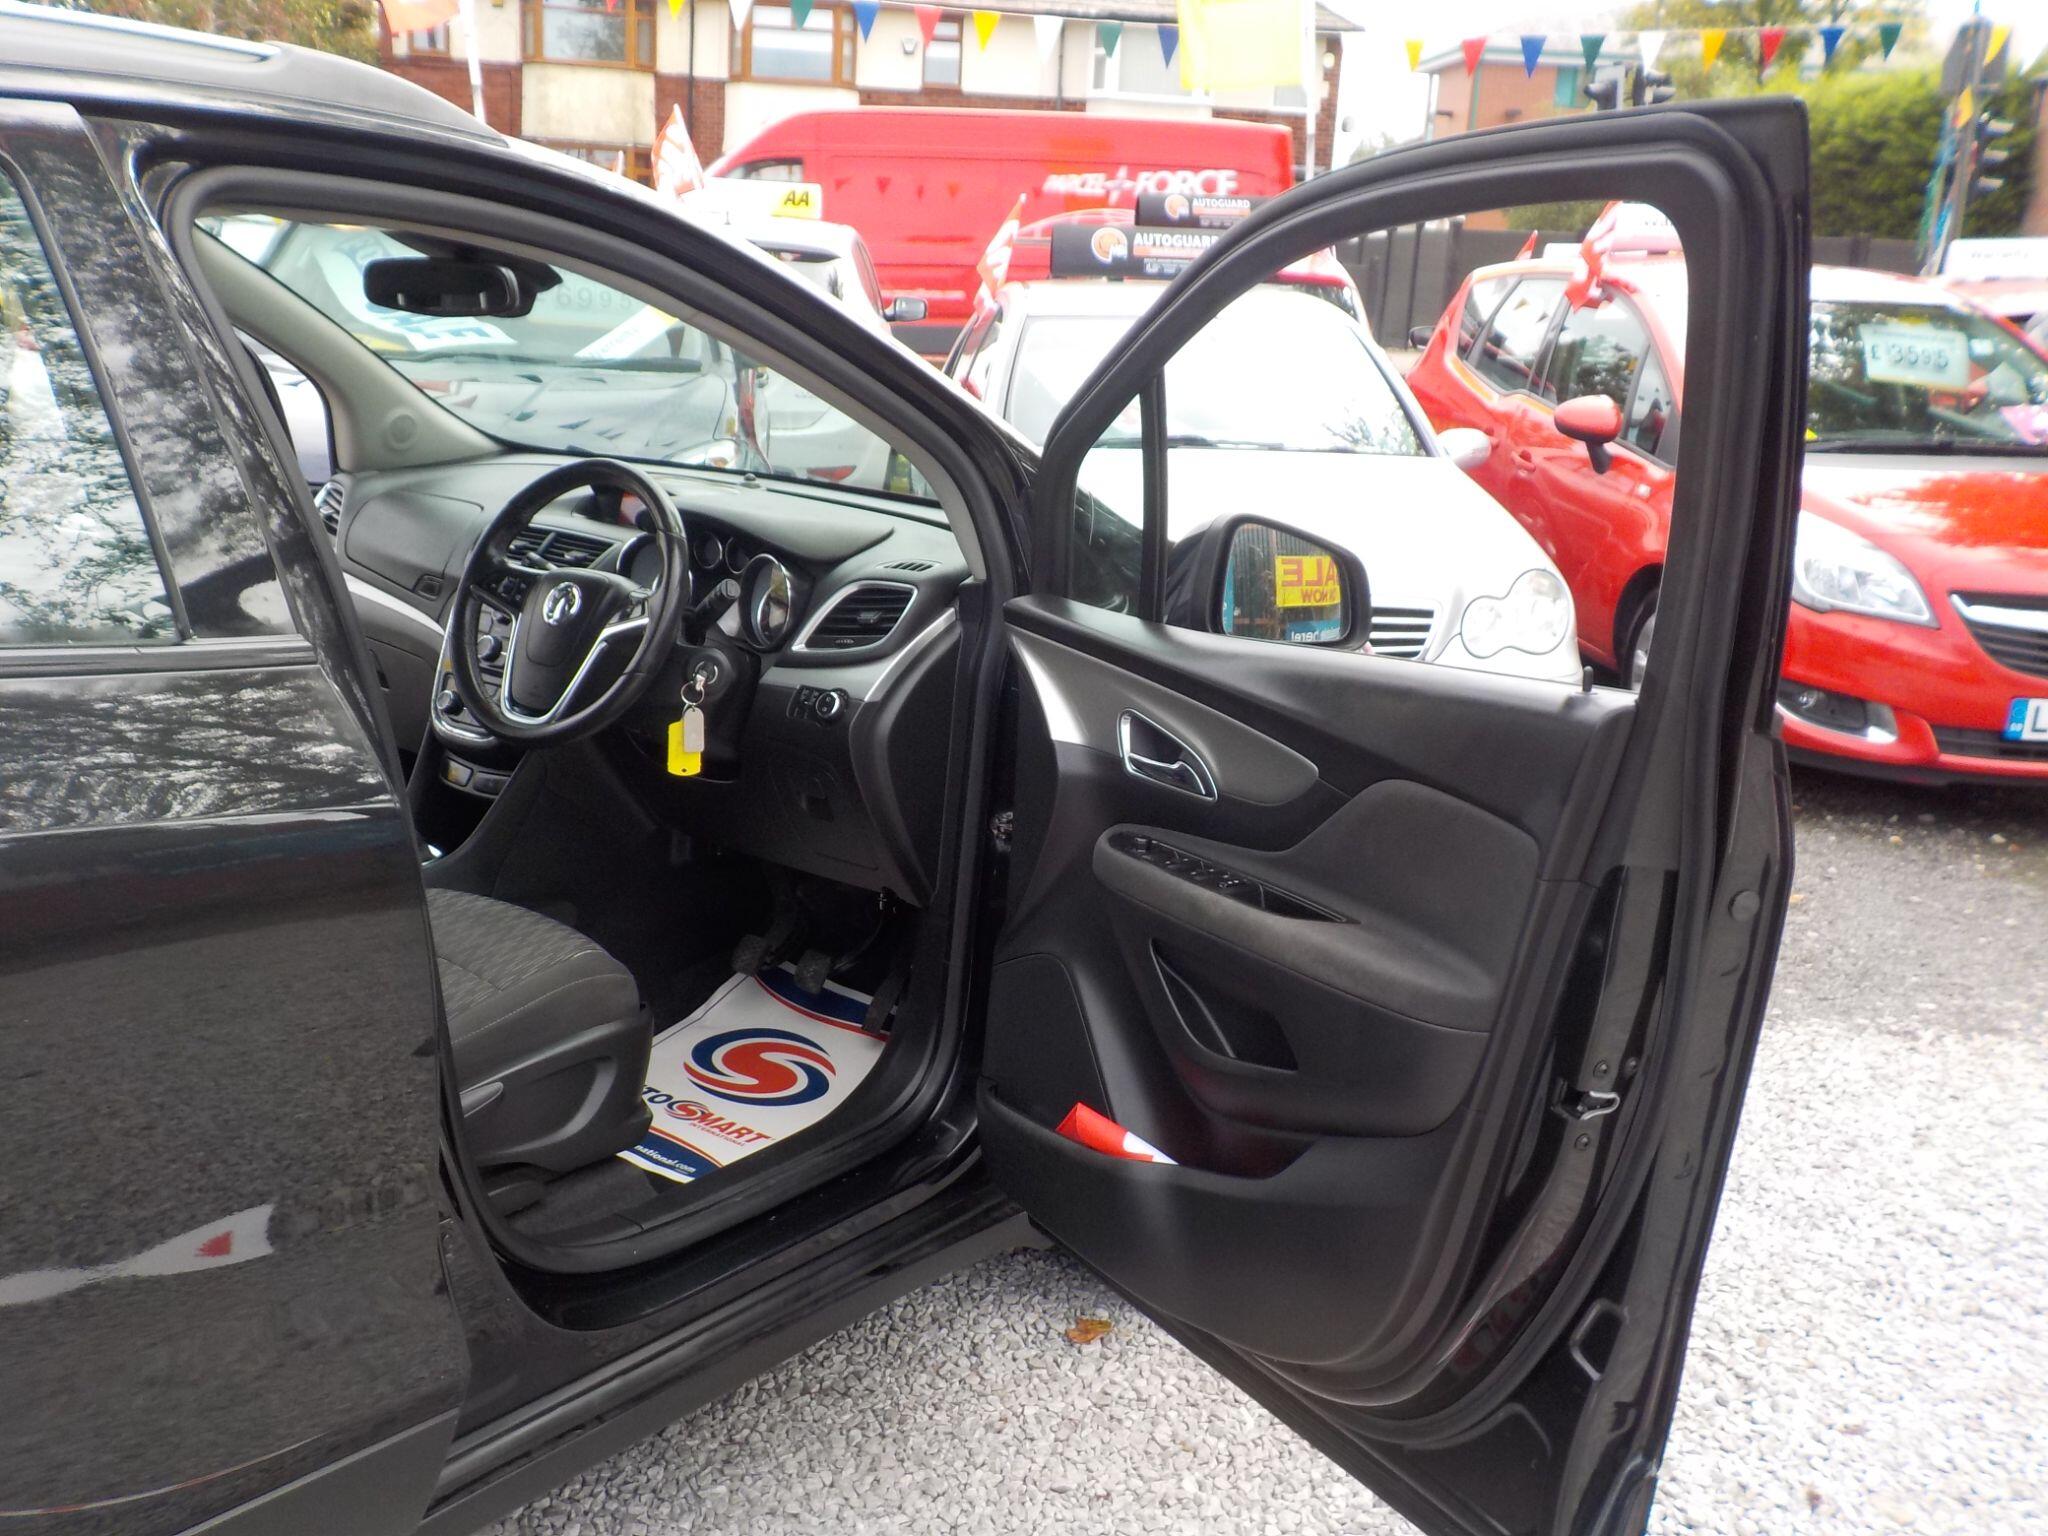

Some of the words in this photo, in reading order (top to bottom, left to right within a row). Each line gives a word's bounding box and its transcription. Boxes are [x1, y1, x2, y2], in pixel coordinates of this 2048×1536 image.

[1135, 169, 1239, 196] FORCE
[783, 190, 810, 207] AA
[1192, 198, 1251, 208] AUTOGUARD
[642, 1086, 772, 1143] TOSMART
[633, 1145, 697, 1173] national.com
